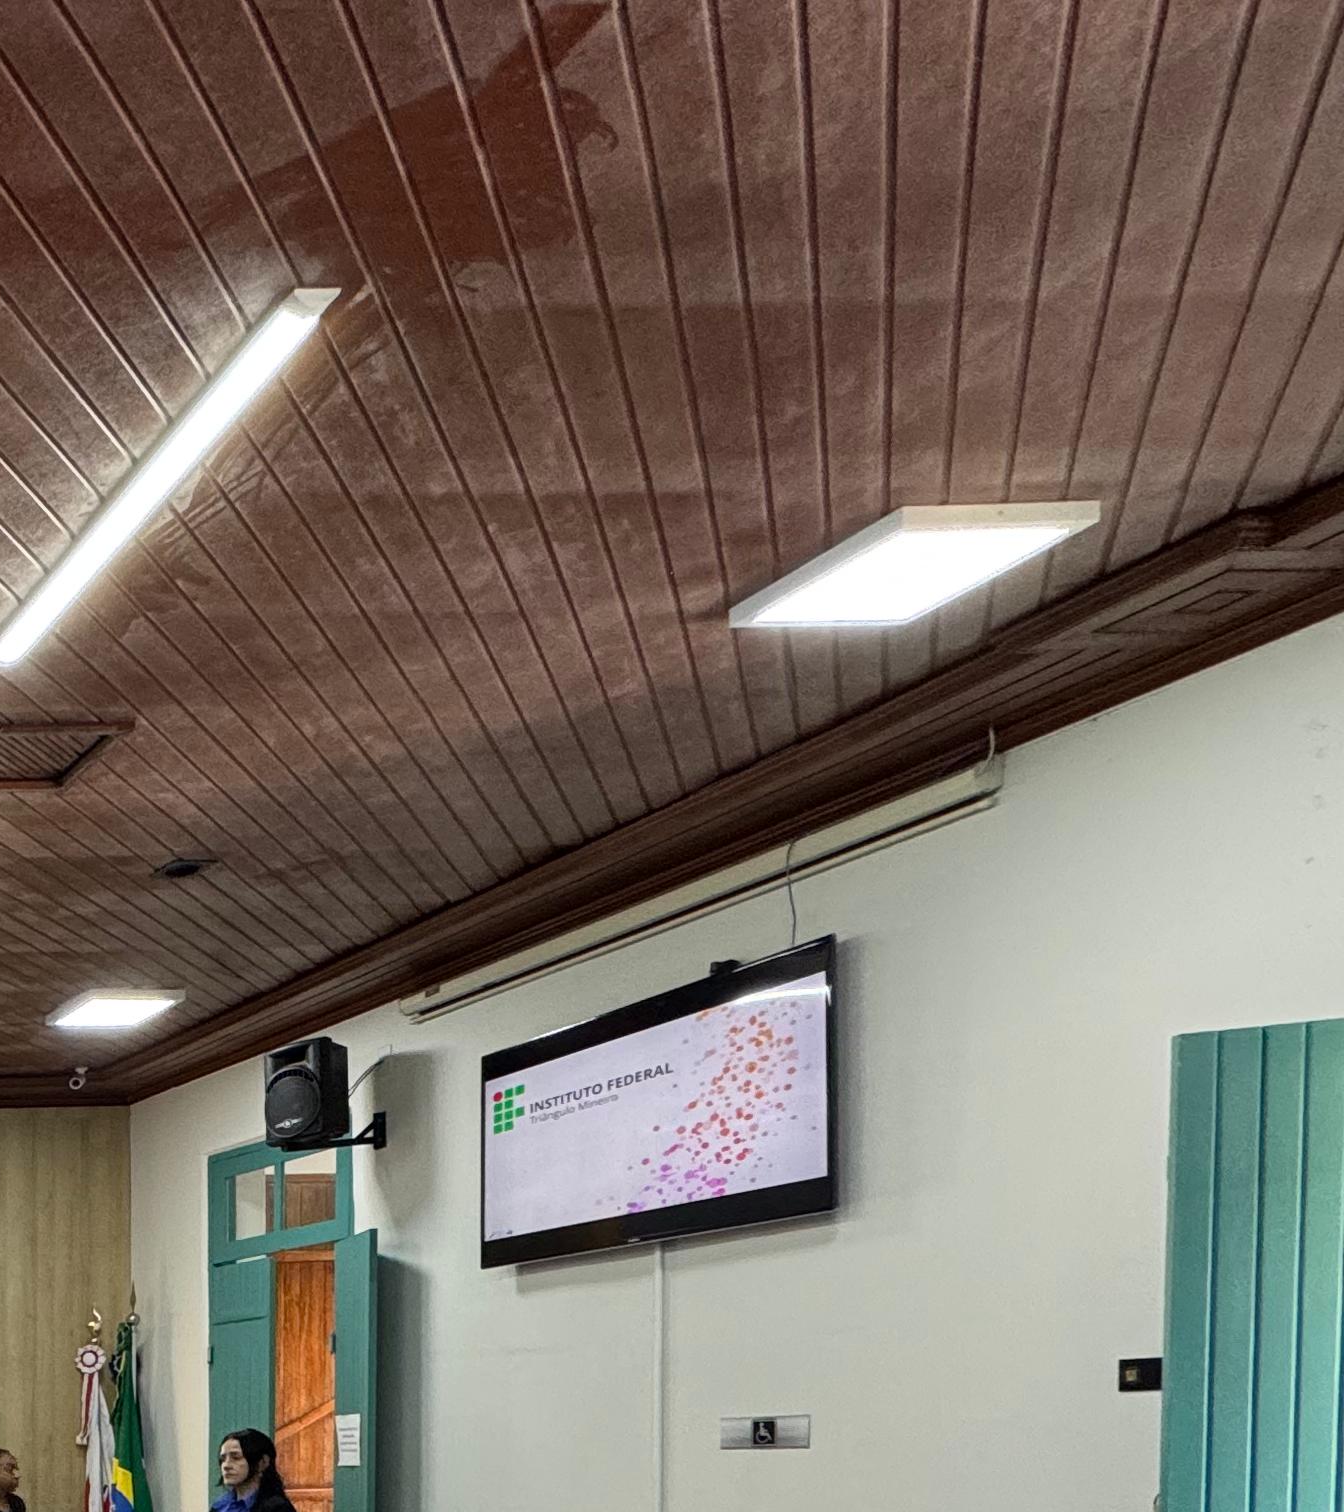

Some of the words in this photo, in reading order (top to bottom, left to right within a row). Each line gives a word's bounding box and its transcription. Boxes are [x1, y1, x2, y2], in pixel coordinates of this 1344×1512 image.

[529, 1083, 603, 1114] INSTITUTO
[607, 1062, 674, 1092] FEDERAL
[529, 1106, 576, 1125] Triângulo
